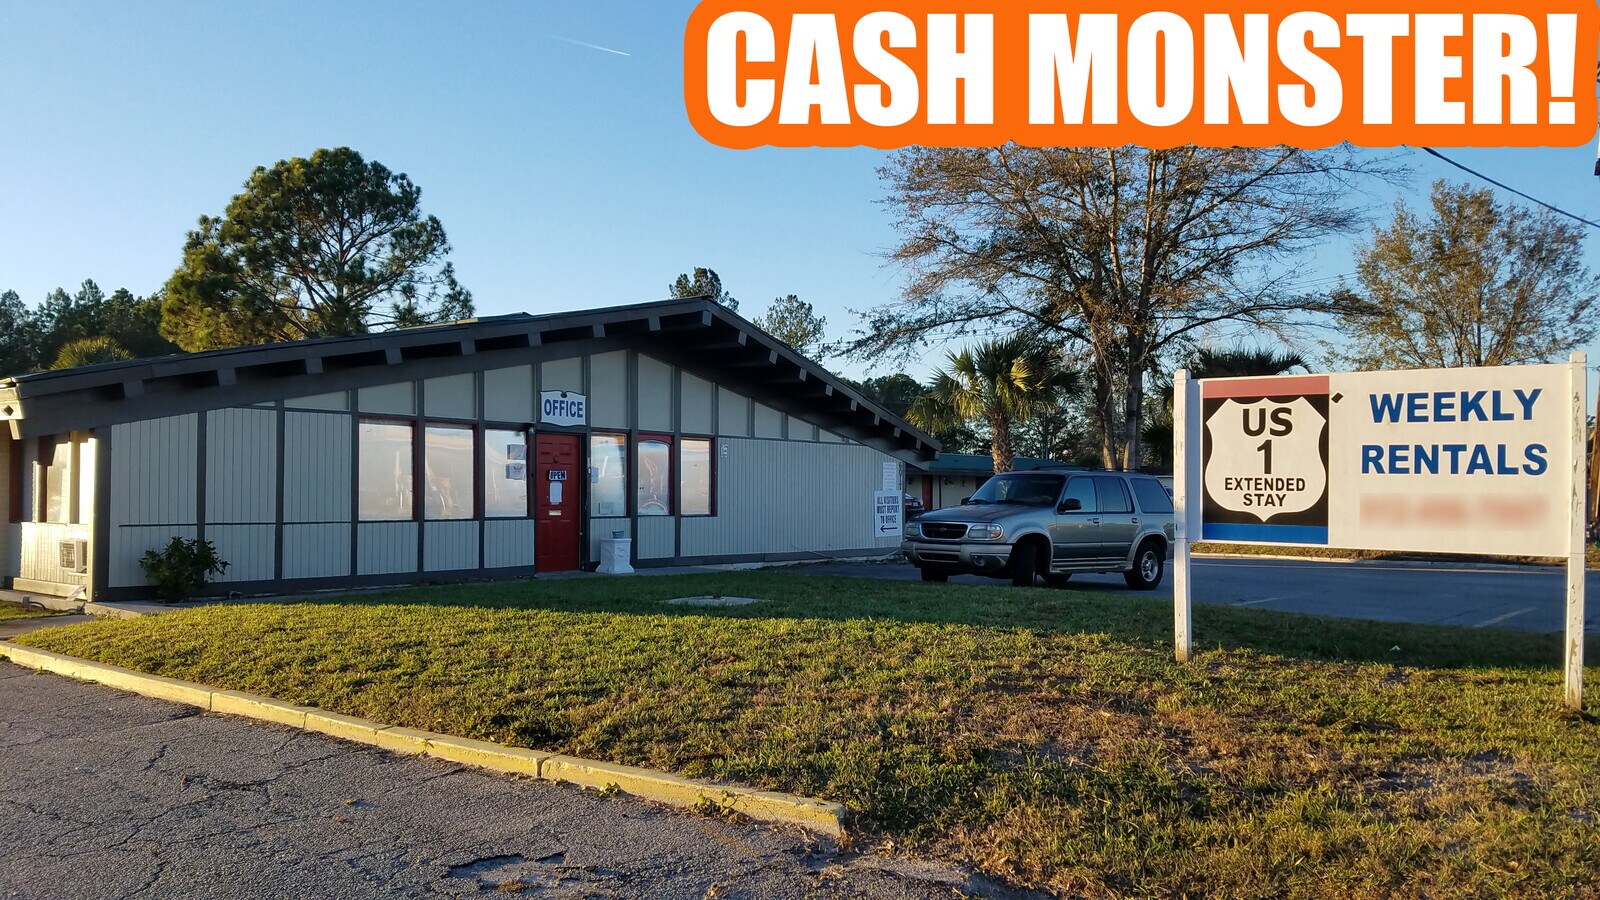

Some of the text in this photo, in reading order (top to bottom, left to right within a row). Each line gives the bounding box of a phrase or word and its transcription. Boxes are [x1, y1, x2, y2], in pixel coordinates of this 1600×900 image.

[544, 398, 584, 418] OFFICE
[1369, 388, 1543, 424] WEEKLY
[1242, 407, 1293, 437] US
[1256, 439, 1272, 475] 1
[1361, 443, 1548, 476] RENTALS
[550, 471, 566, 480] OPEN
[1224, 477, 1306, 492] EXTENDED
[884, 496, 899, 504] VISITORS
[1243, 493, 1287, 507] STAY
[877, 505, 899, 514] MUST REPORT
[880, 515, 897, 524] TO OFFICE
